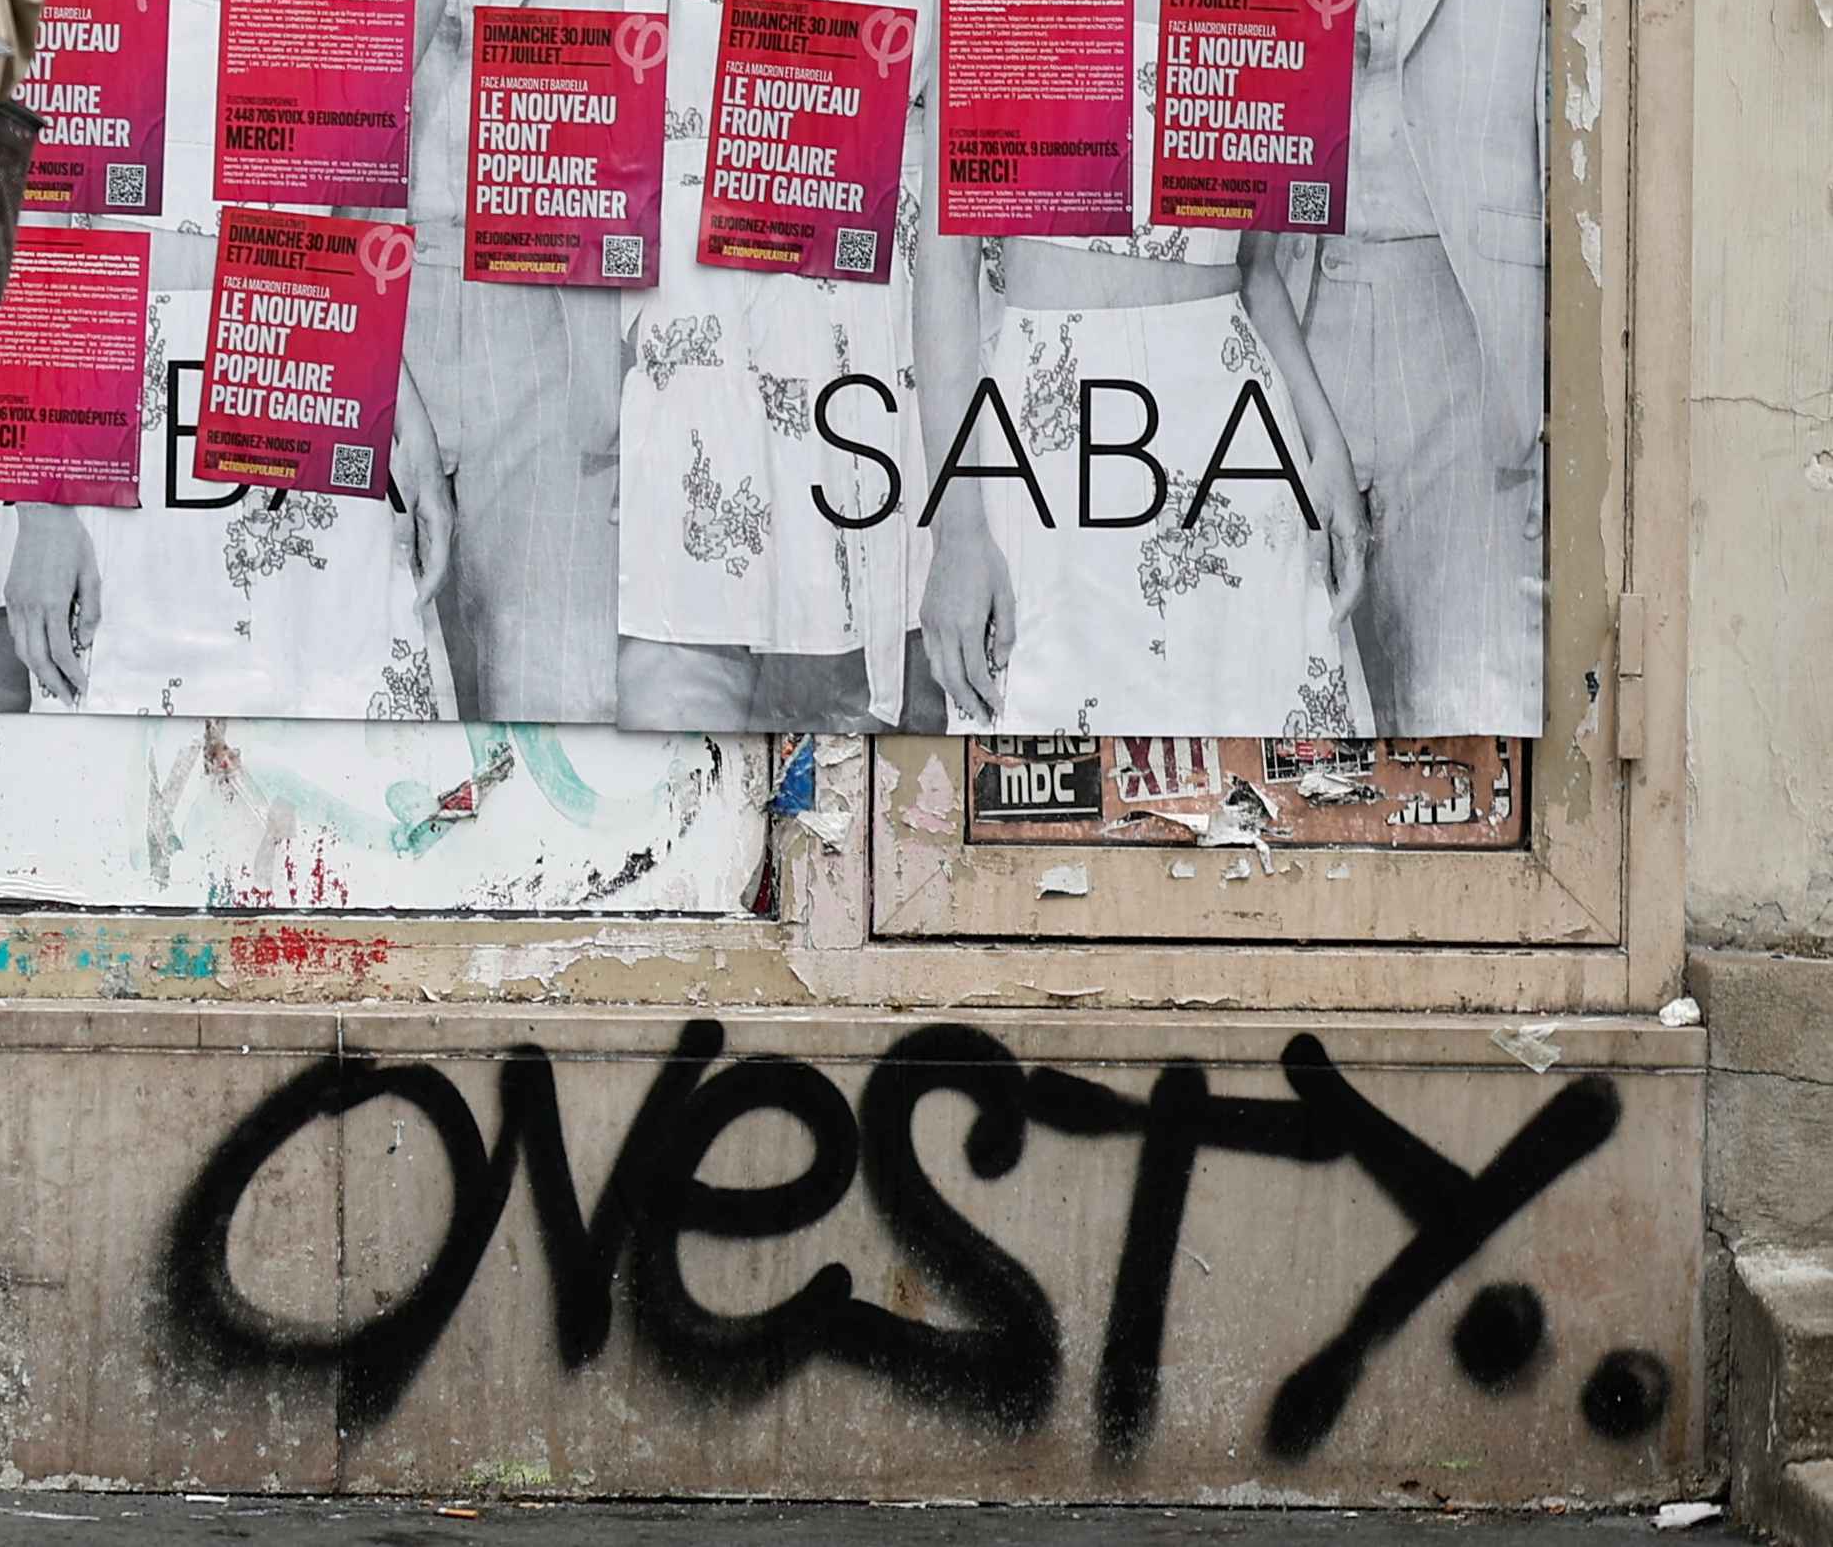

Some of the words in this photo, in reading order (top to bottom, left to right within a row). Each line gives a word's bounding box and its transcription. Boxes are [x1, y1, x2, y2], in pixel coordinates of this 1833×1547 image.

[1167, 35, 1192, 67] LE
[1198, 36, 1304, 69] NOUVEAU
[1165, 65, 1238, 98] FRONT
[1163, 99, 1285, 132] POPULAIRE
[1163, 130, 1218, 162] PEUT
[1221, 131, 1315, 165] GAGNER
[811, 372, 1321, 533] SABA
